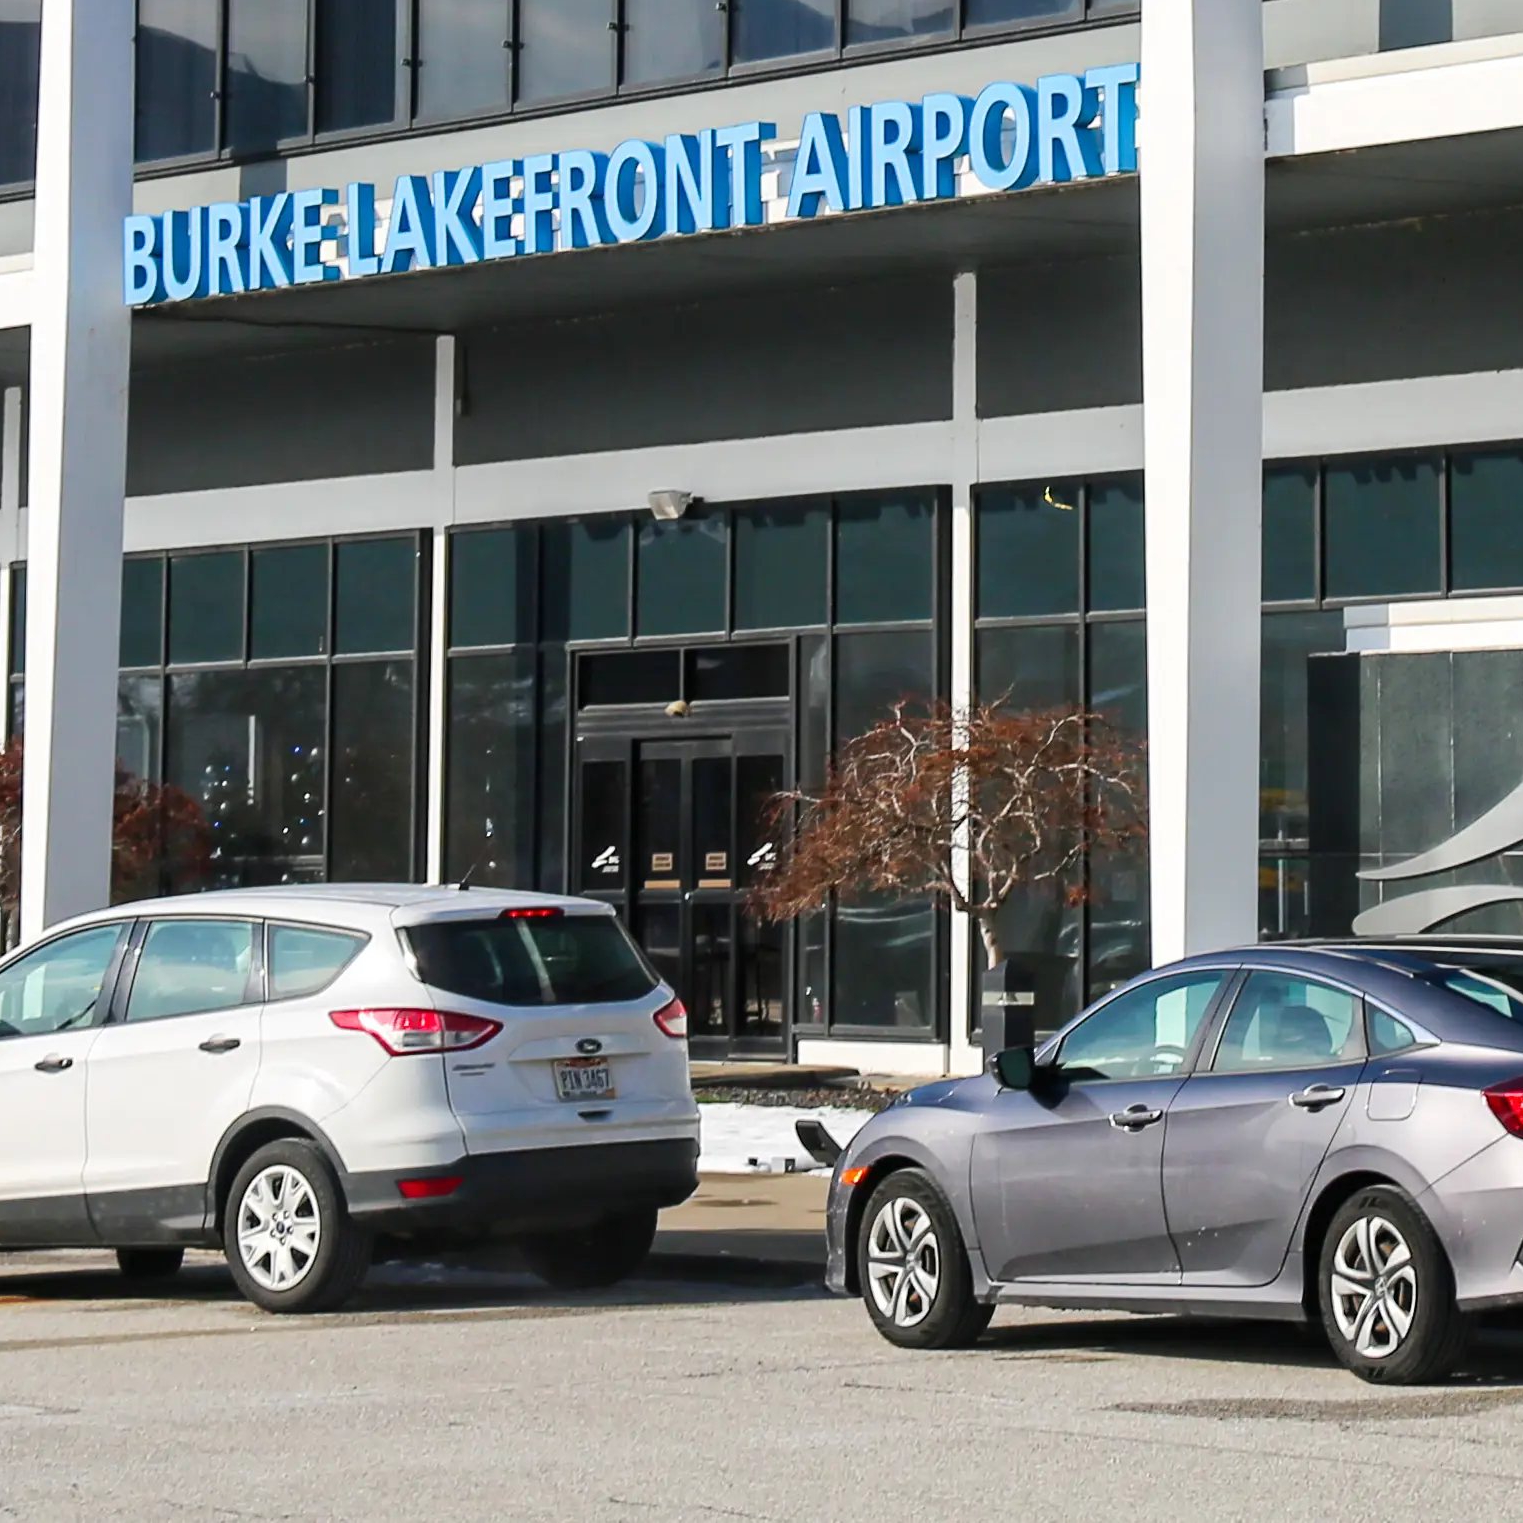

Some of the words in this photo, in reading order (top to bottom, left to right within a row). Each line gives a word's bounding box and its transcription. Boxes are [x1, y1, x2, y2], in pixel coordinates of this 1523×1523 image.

[123, 189, 334, 307] BURKE
[346, 122, 774, 277] LAKEFRONT
[786, 62, 1139, 218] AIRPORT
